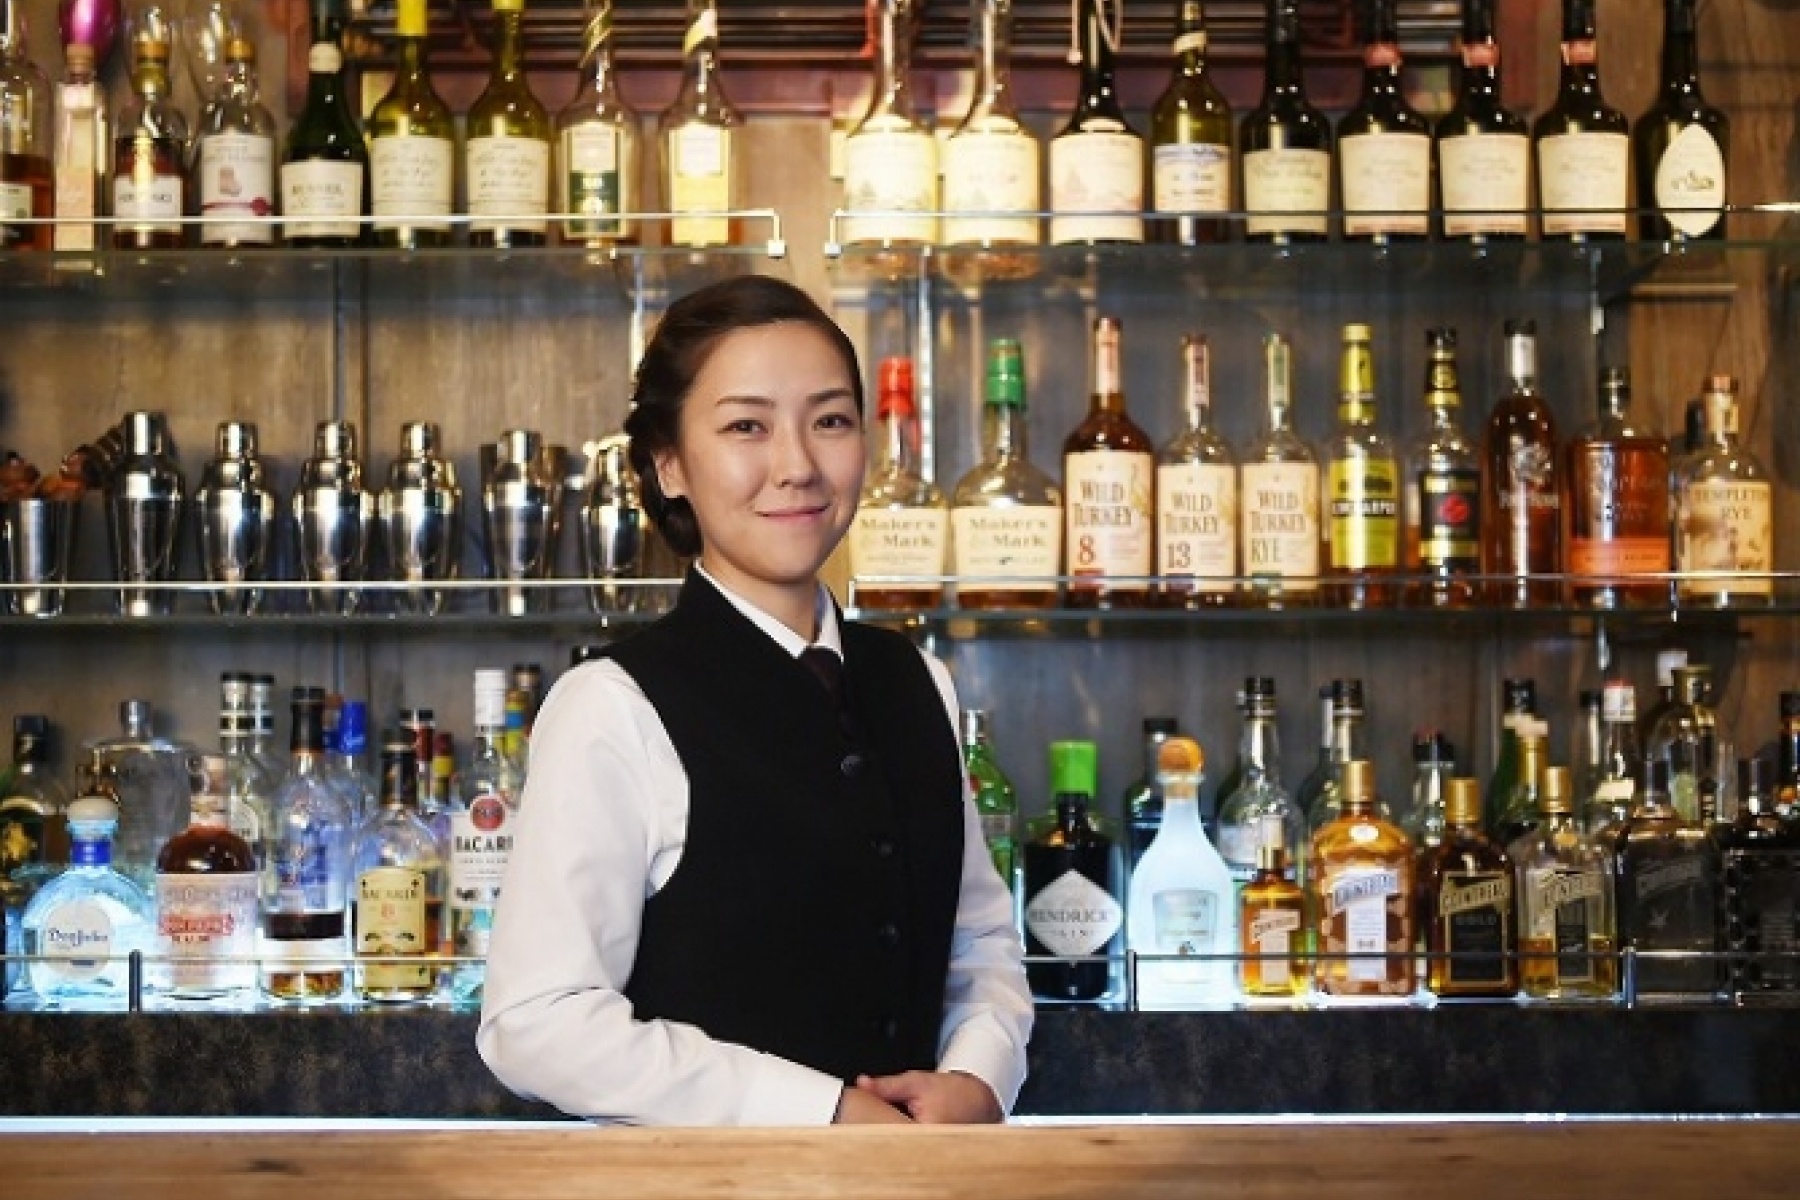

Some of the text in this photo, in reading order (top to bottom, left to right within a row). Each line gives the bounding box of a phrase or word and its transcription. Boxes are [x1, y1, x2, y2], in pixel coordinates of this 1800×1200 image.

[1171, 491, 1213, 512] WILD
[1257, 490, 1299, 511] WILD
[1165, 513, 1218, 534] TURKEY
[884, 534, 935, 547] Mark
[993, 534, 1046, 547] Mark
[1079, 535, 1096, 565] 8
[1166, 541, 1191, 569] 13
[1251, 538, 1280, 565] RYE
[455, 836, 514, 853] BACAR
